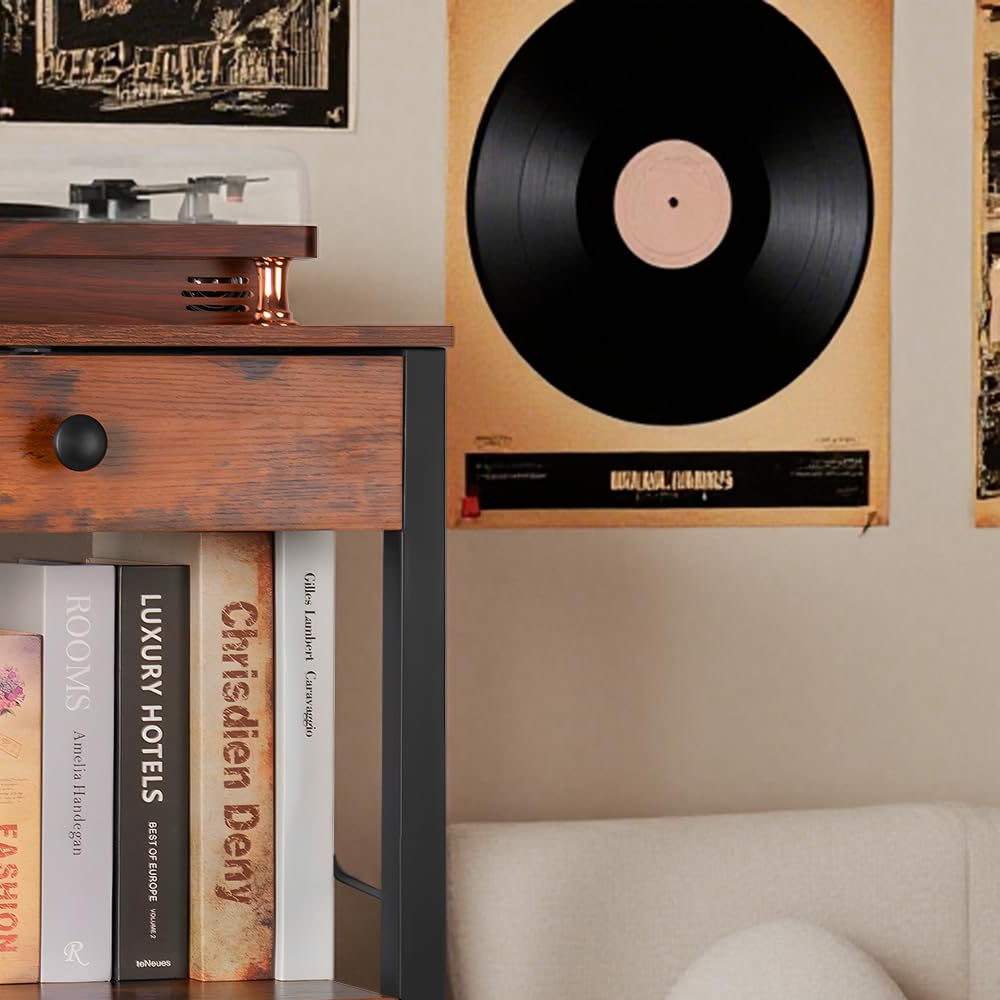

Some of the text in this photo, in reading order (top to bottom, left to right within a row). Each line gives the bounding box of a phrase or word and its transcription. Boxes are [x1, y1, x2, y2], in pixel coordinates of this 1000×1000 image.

[65, 593, 92, 711] ROOMS
[141, 594, 164, 803] LUXURY HOTELS
[303, 572, 317, 738] Gilles Lambert Caravaggio
[68, 730, 86, 856] Amelia Handegan
[215, 600, 260, 904] Chrisdien Deny
[148, 821, 158, 902] BEST OF EUROPE
[135, 959, 172, 969] teNeues
